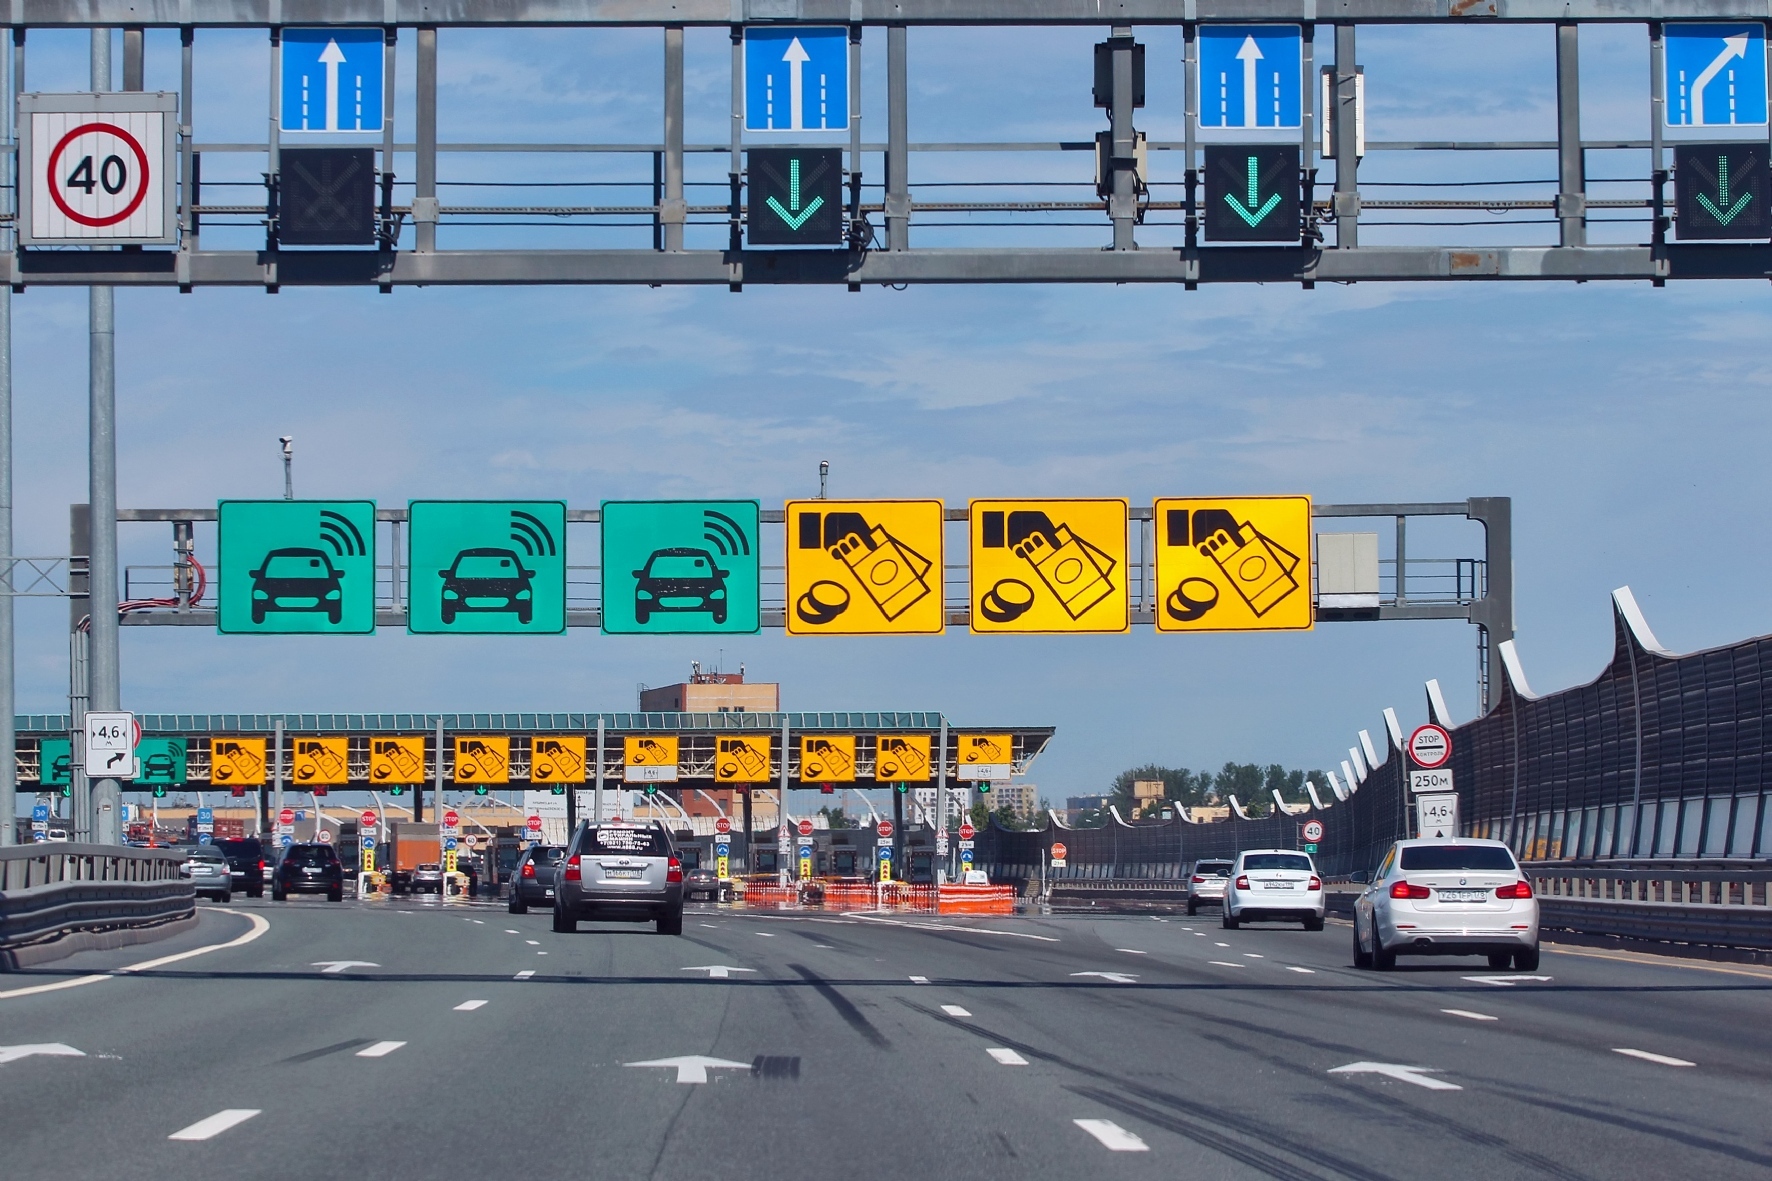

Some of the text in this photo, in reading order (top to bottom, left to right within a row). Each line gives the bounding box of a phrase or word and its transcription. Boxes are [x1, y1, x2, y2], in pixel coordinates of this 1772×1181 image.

[67, 154, 127, 195] 40
[98, 725, 120, 739] 4,6
[1418, 735, 1440, 744] STOP
[35, 809, 46, 817] 30
[200, 811, 211, 819] 30
[1429, 805, 1448, 818] 4,6
[1307, 827, 1320, 835] 40
